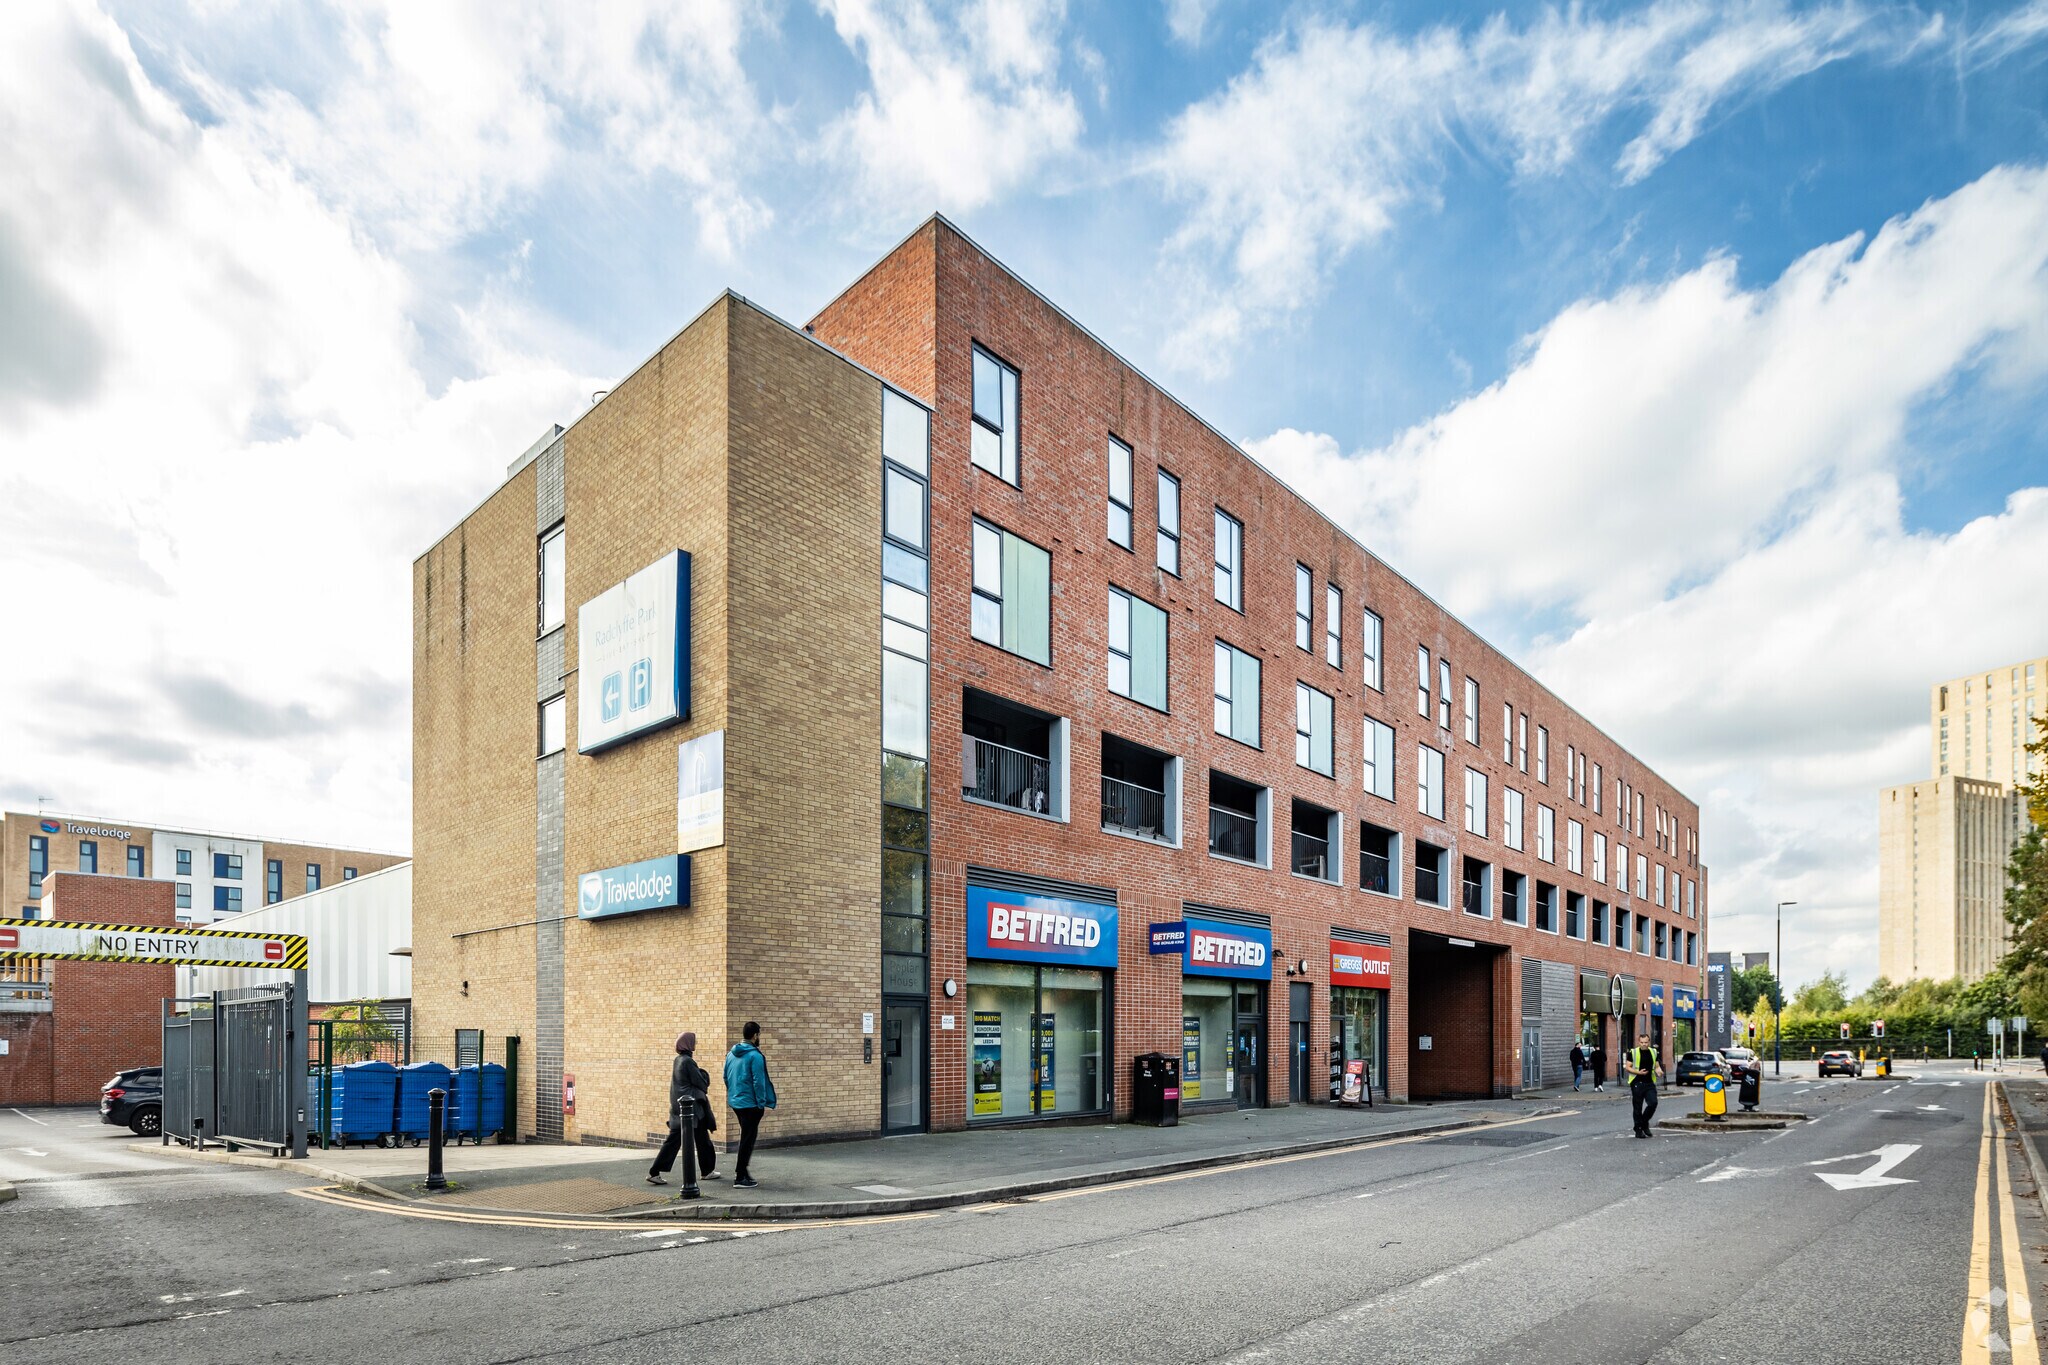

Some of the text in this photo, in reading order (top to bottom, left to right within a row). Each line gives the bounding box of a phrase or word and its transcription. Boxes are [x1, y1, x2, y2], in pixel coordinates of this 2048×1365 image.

[595, 600, 656, 647] Radclyffe Park
[65, 822, 131, 841] Travelodge
[605, 870, 672, 904] Travelodge
[990, 907, 1101, 948] BETFRED
[1153, 931, 1185, 941] BETFRED
[100, 936, 199, 955] NO ENTRY
[1193, 935, 1266, 967] BETFRED
[890, 960, 920, 975] Poplar
[1340, 958, 1390, 975] GREGGS OUTLET
[890, 974, 919, 987] House
